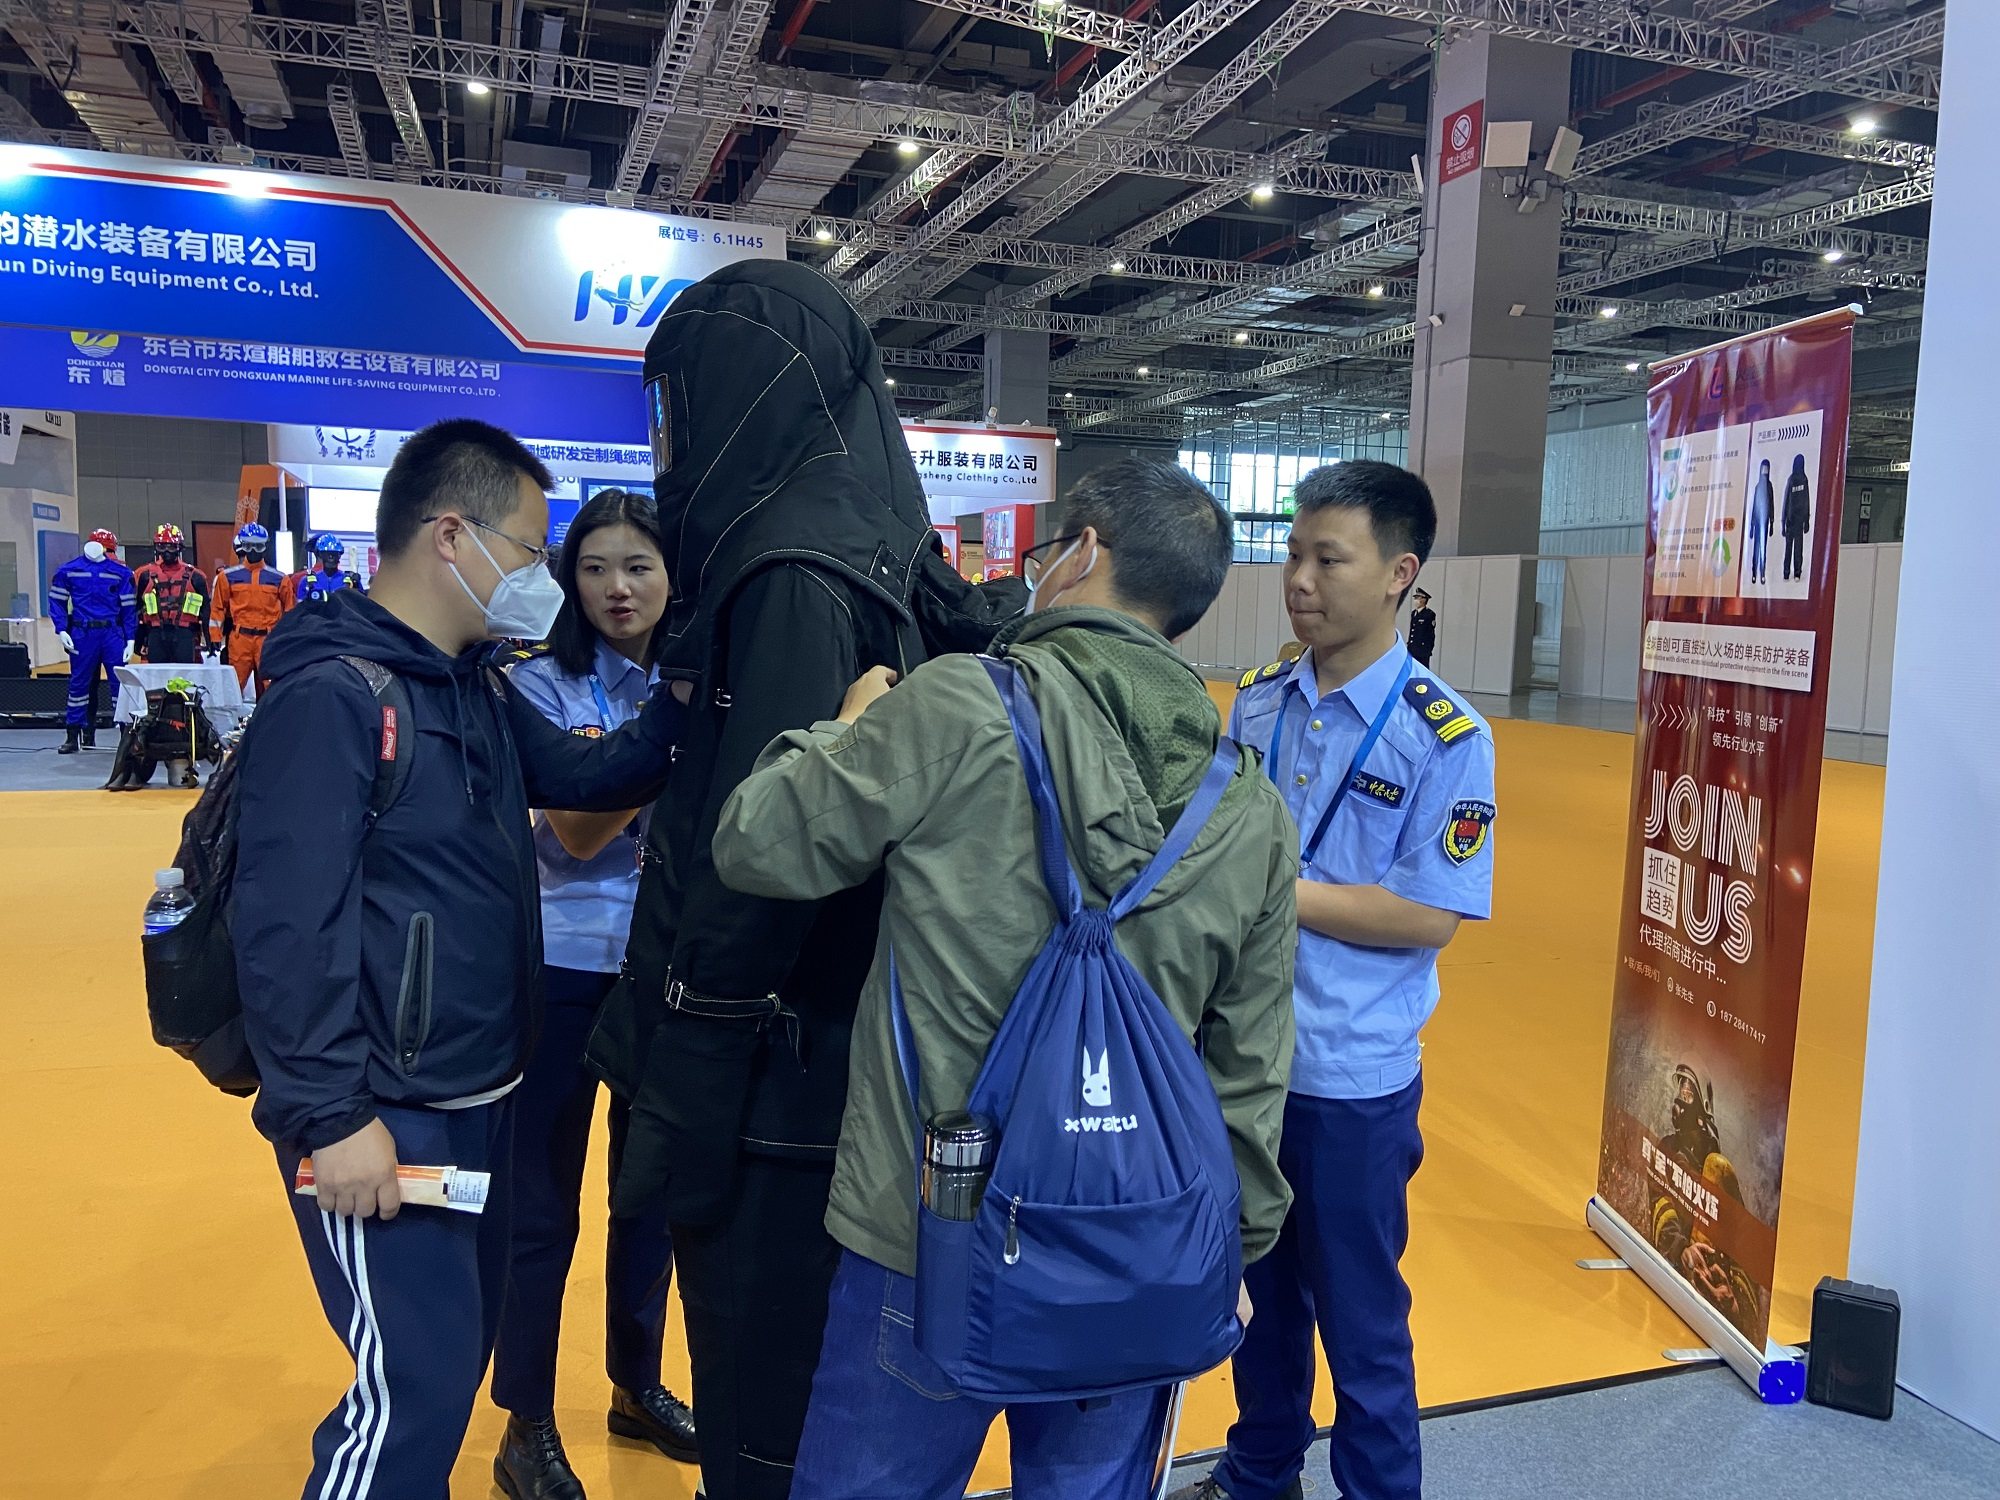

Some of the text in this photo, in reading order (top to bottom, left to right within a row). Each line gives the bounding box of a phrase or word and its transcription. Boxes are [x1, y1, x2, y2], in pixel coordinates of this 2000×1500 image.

[32, 258, 104, 284] Diving
[111, 265, 228, 291] Equipment
[234, 276, 274, 296] Co.,
[280, 280, 319, 299] Ltd.
[67, 358, 125, 368] DONGXUAN
[144, 364, 194, 376] DONGTAI
[196, 367, 220, 378] CITY
[222, 369, 286, 383] DONGXUAN
[288, 373, 330, 385] MARINE
[332, 376, 396, 390] LIFE-SAVING
[398, 382, 457, 394] EQUIPMENT
[956, 472, 998, 484] Clothing
[1720, 661, 1744, 670] protective
[1771, 667, 1780, 676] the
[1781, 668, 1791, 677] fire
[1791, 670, 1809, 679] scene
[1735, 710, 1752, 728] 引领
[1712, 732, 1765, 757] 领先行业水平
[1644, 769, 1762, 876] JOIN
[1648, 854, 1677, 887] 抓住
[1646, 889, 1675, 921] 趋势
[1682, 862, 1756, 965] US
[1675, 983, 1694, 1004] 张先生
[1064, 1114, 1138, 1133] xwatu
